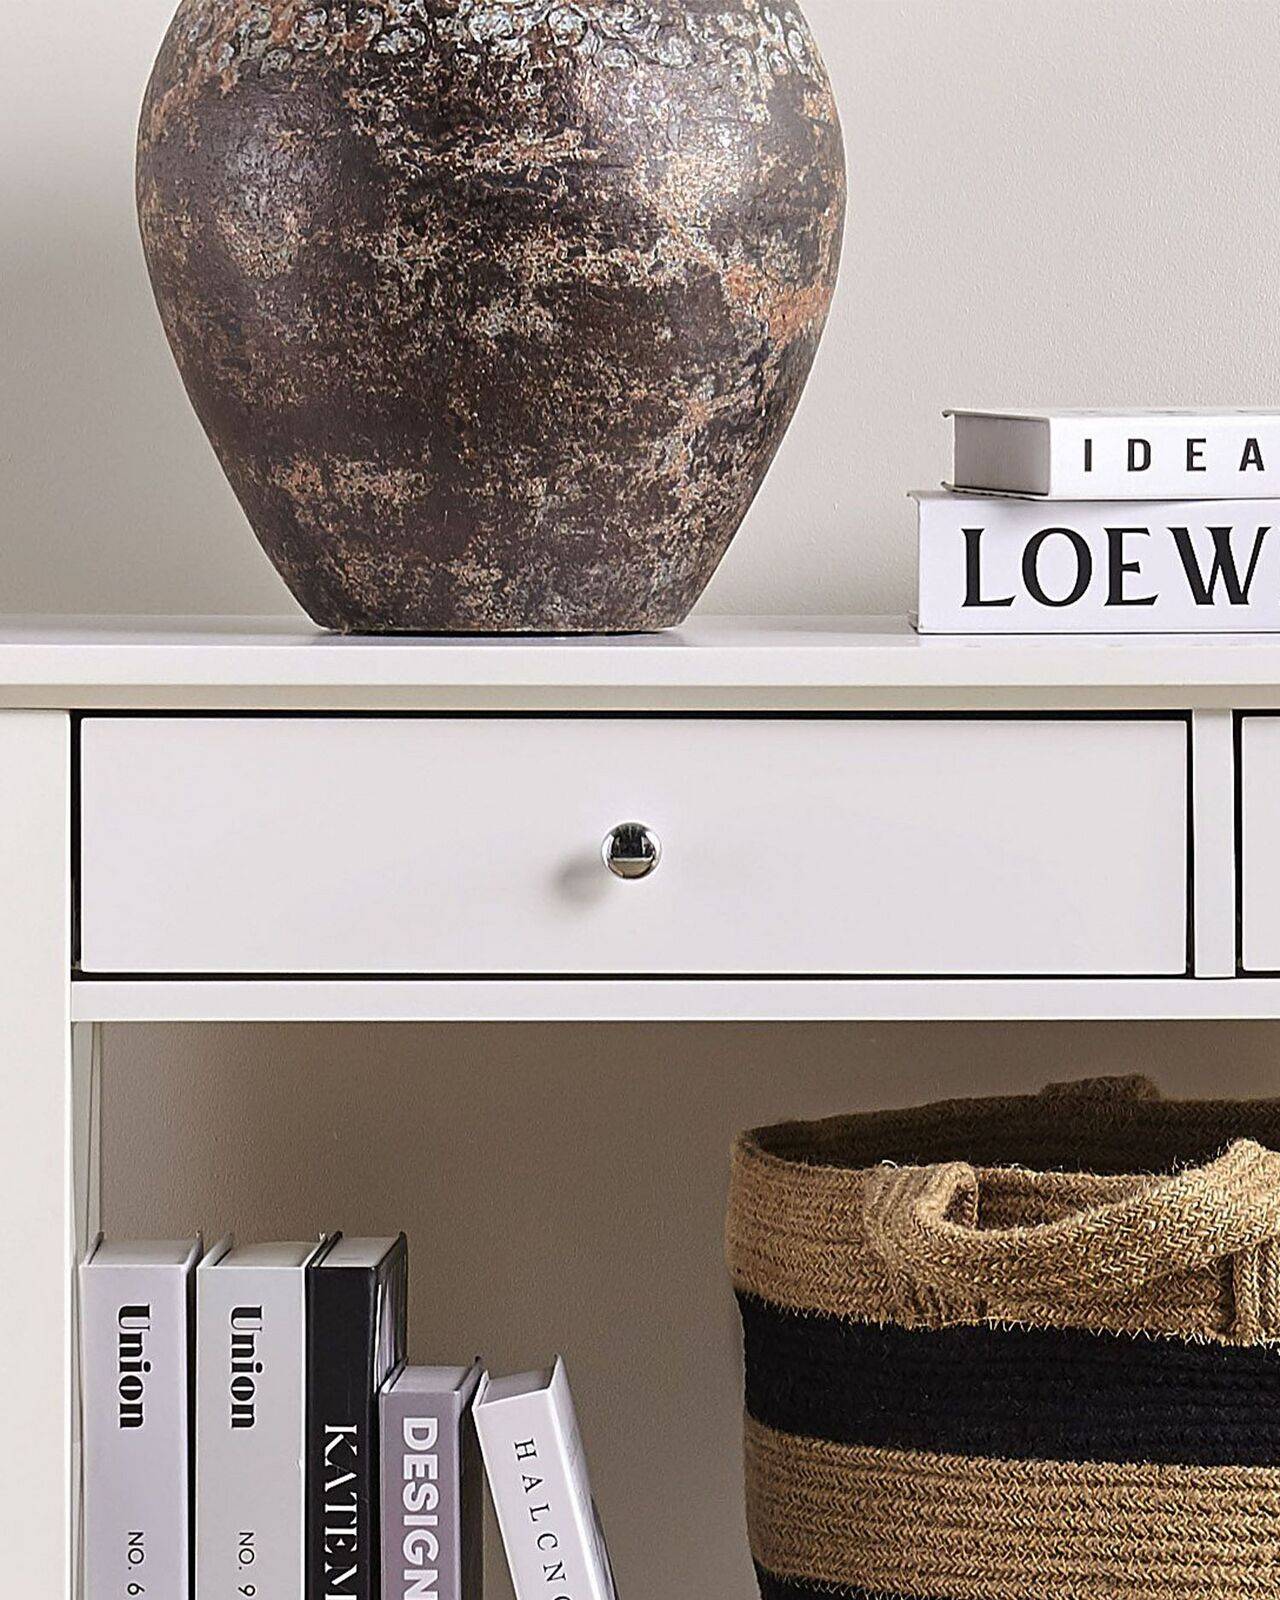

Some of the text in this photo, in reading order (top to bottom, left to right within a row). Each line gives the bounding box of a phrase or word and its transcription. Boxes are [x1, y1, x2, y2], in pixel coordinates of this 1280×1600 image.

[1084, 437, 1265, 472] IDEA
[118, 1304, 151, 1429] Union
[230, 1305, 263, 1429] Union
[324, 1424, 358, 1554] KATE
[127, 1531, 145, 1571] NO.
[238, 1532, 255, 1570] NO.
[127, 1582, 145, 1596] 6
[237, 1584, 256, 1597] 9
